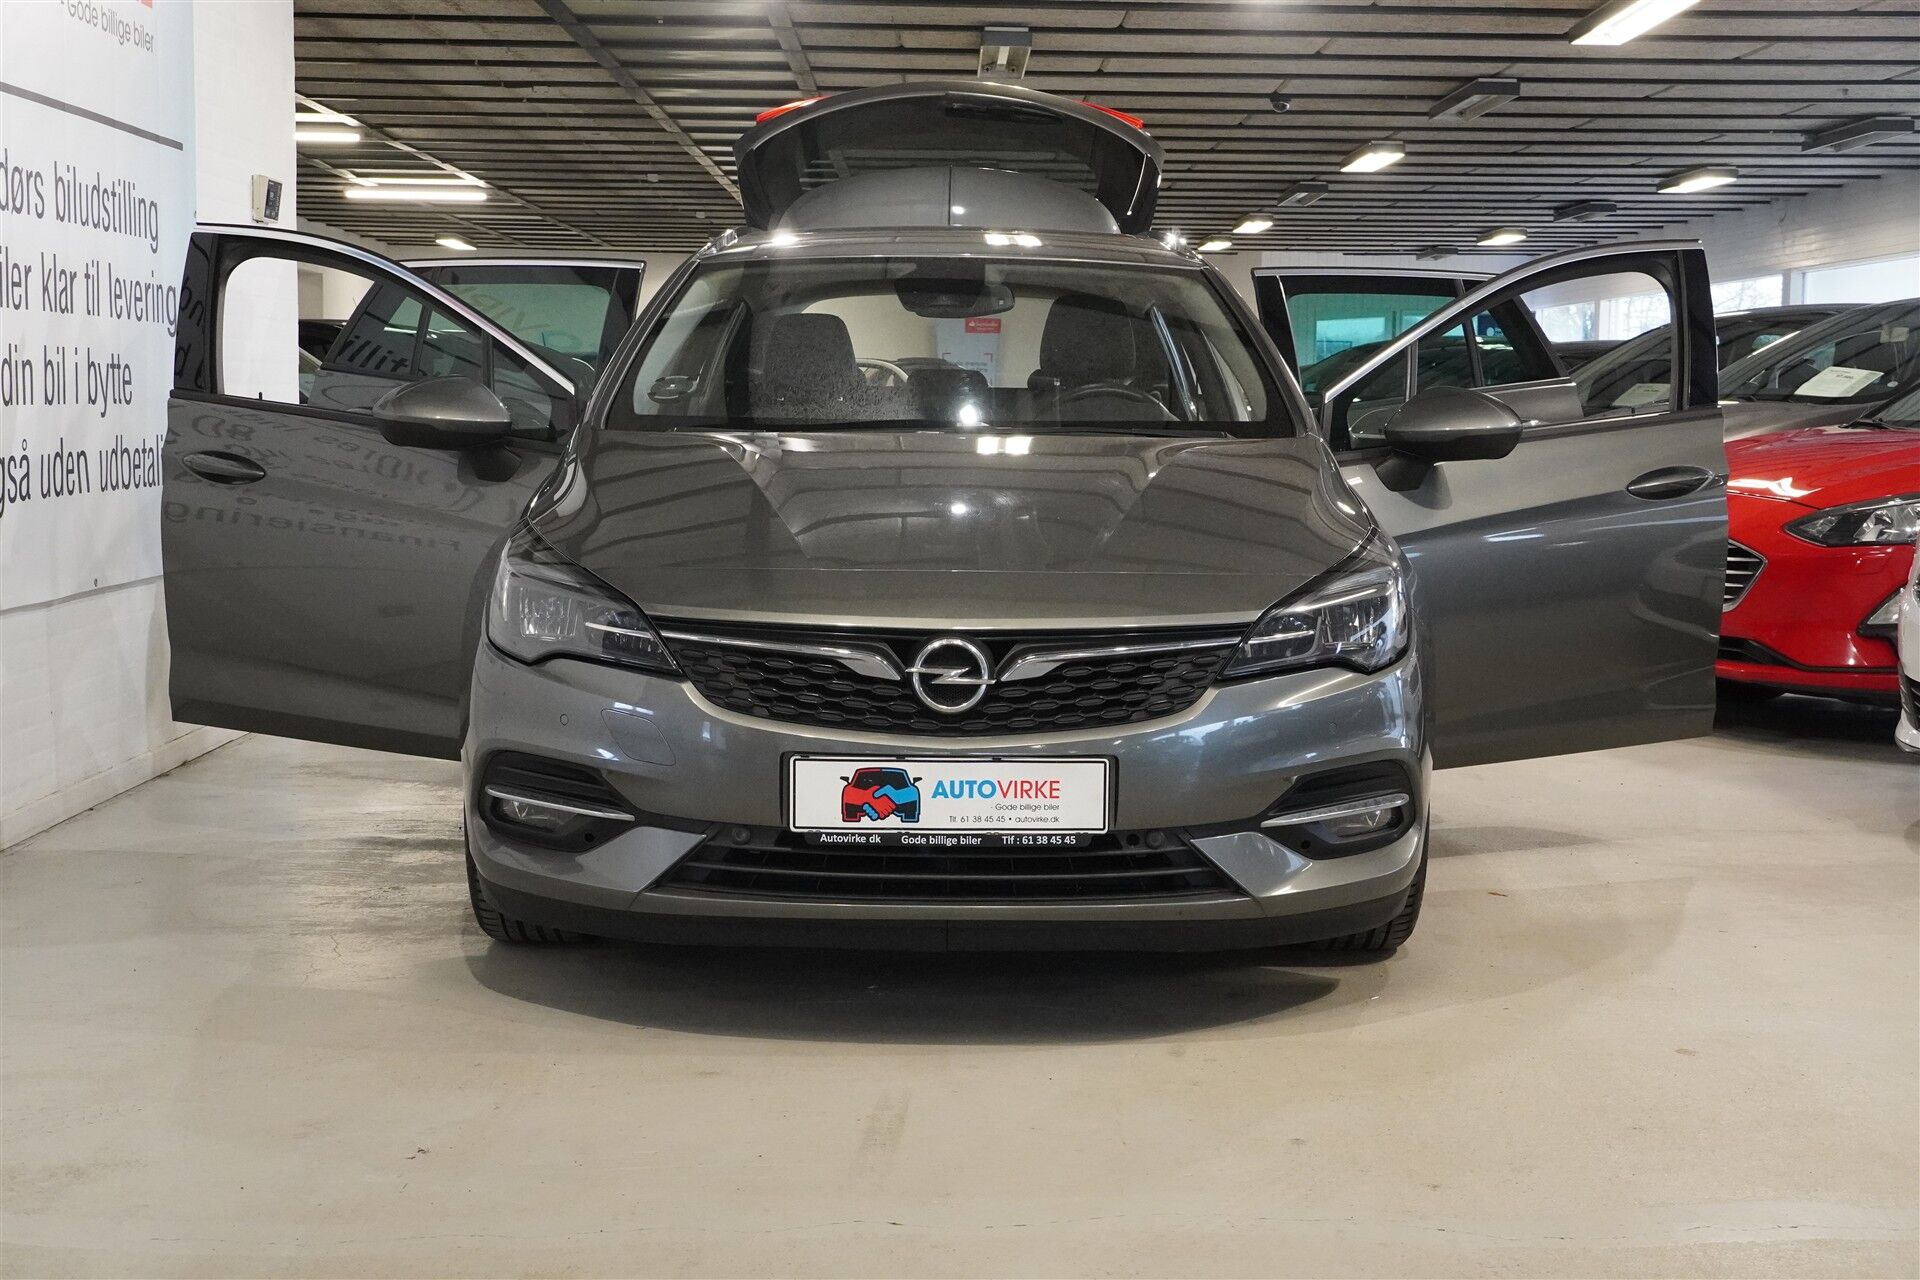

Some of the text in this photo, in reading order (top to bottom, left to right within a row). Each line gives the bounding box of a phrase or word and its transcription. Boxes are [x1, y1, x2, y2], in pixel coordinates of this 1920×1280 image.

[67, 0, 98, 27] Gode
[101, 5, 131, 45] billige
[133, 20, 154, 52] biler
[54, 161, 159, 254] biludstilling
[41, 251, 77, 315] klar
[85, 259, 100, 317] til
[108, 262, 176, 338] levering
[2, 343, 133, 418] din bil i bytte
[41, 437, 91, 499] uden
[100, 434, 164, 493] udbetal
[931, 779, 1060, 799] AUTOVIRKE
[995, 803, 1018, 811] Gode
[1019, 803, 1042, 812] billige
[1044, 803, 1060, 811] biler
[820, 834, 867, 843] Autovirke
[869, 834, 881, 843] dk
[901, 835, 927, 845] Gode
[929, 835, 958, 847] billige
[960, 835, 982, 845] biler
[1001, 835, 1015, 845] Tlf
[1022, 835, 1034, 845] 61
[1036, 835, 1048, 845] 38
[1050, 835, 1061, 845] 45
[1064, 835, 1076, 845] 45
[960, 815, 969, 823] 61
[972, 815, 982, 823] 38
[984, 815, 994, 823] 45
[996, 815, 1006, 823] 45
[1014, 815, 1060, 823] autovirke.dk
